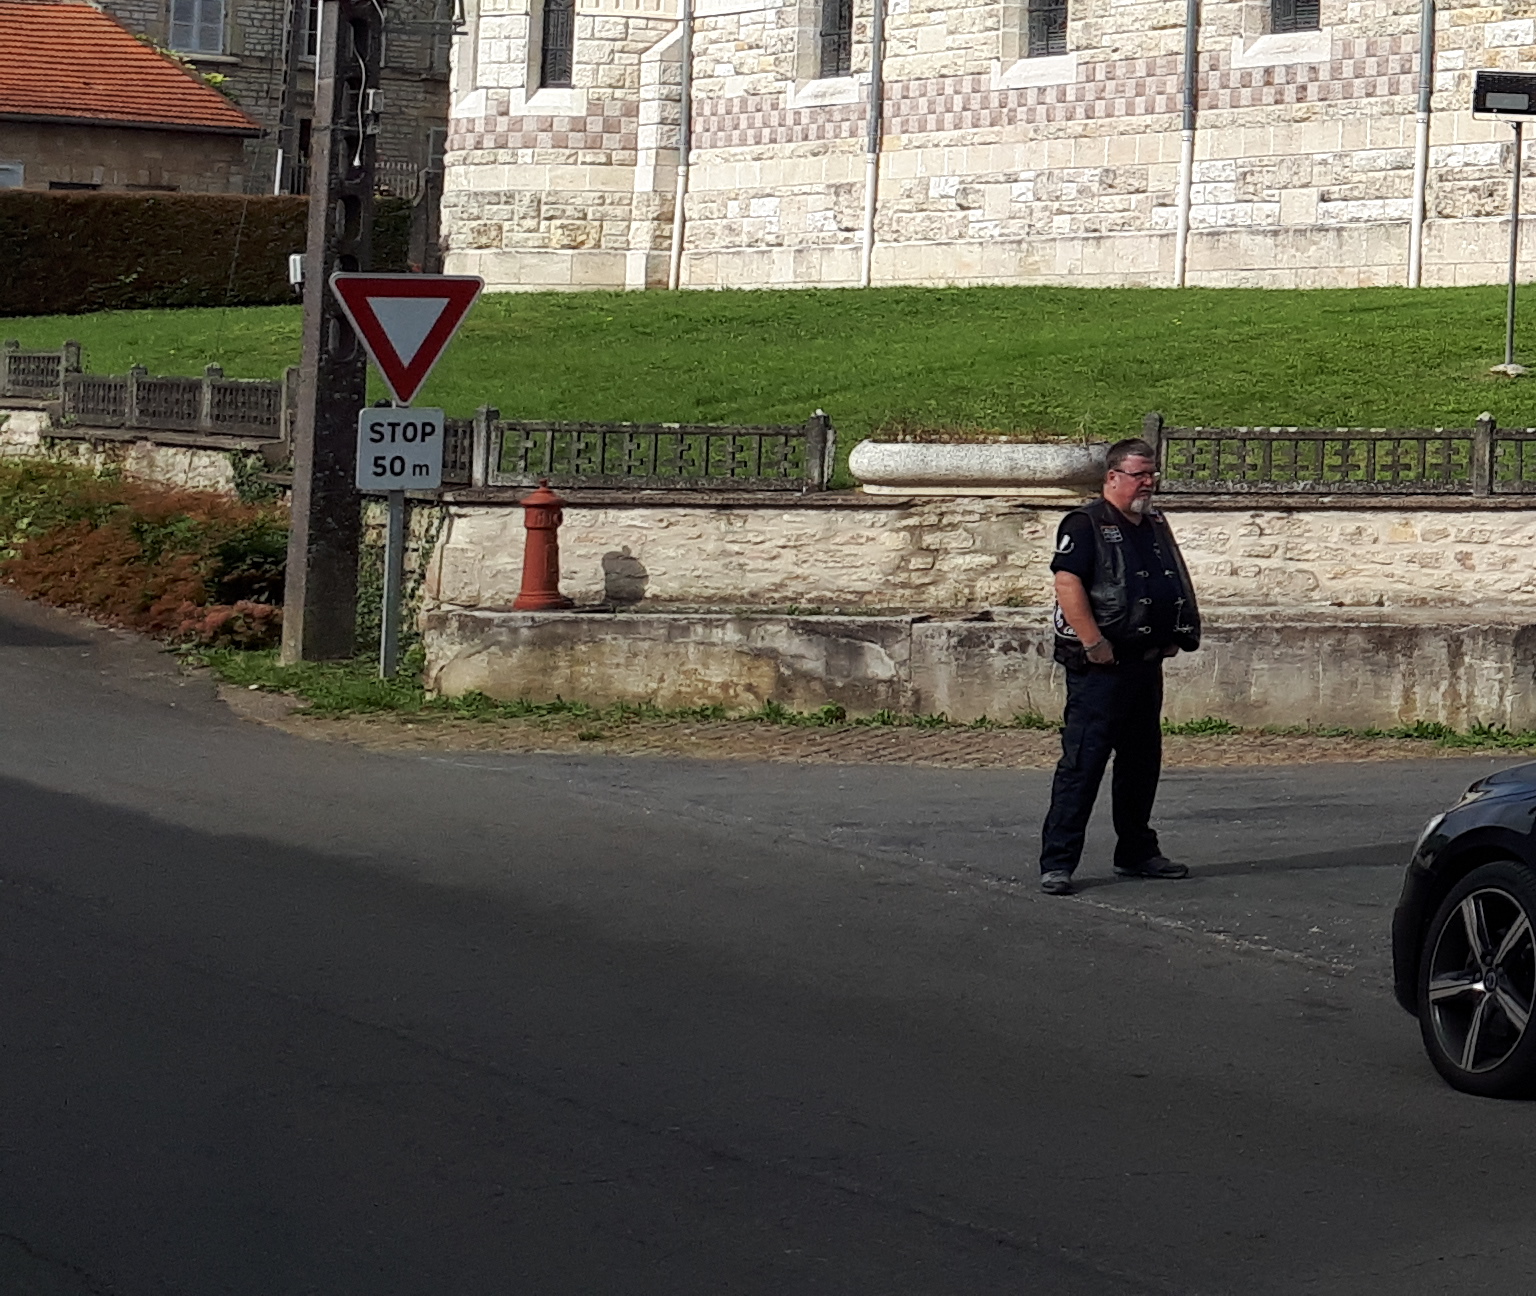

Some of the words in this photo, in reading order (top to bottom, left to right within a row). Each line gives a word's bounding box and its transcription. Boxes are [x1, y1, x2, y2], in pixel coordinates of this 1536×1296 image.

[369, 421, 436, 444] STOP
[372, 455, 405, 478] 50
[412, 462, 430, 477] m
